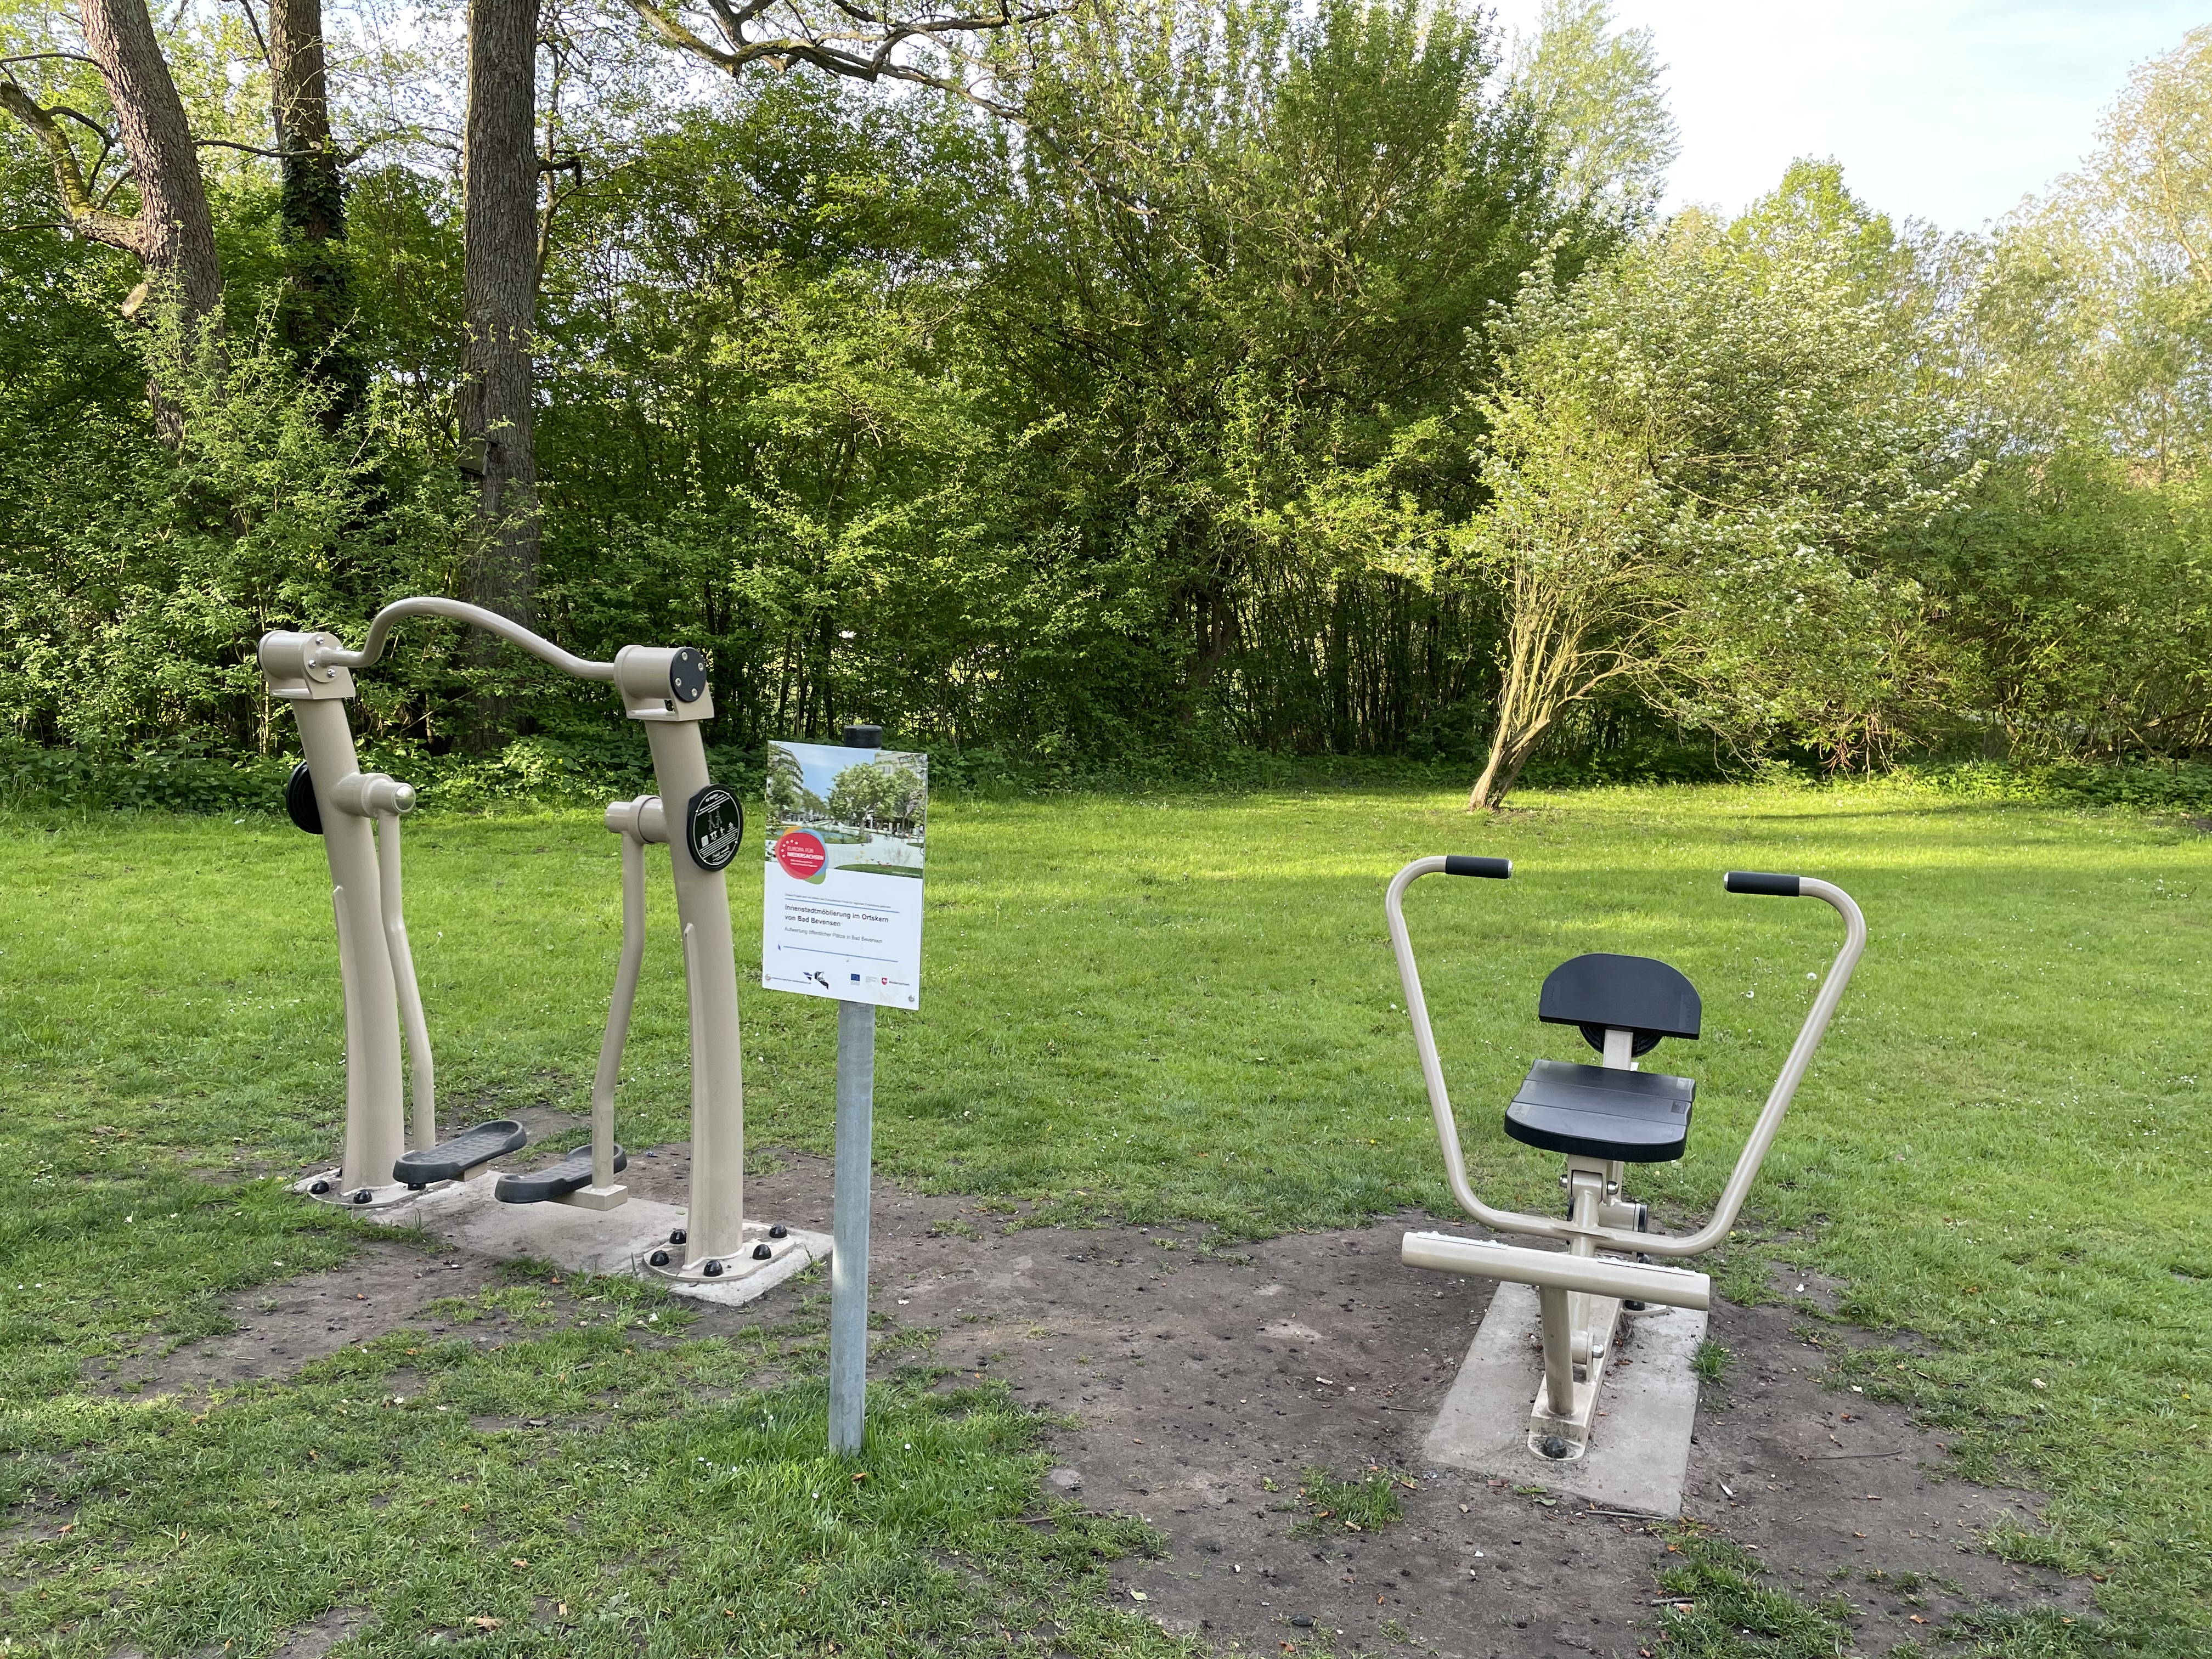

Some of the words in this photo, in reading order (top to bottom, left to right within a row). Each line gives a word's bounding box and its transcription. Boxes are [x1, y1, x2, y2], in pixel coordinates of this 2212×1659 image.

[785, 904, 850, 919] Innenstadtmöblierung
[862, 913, 889, 923] Ortskern
[811, 917, 841, 927] Bevensen
